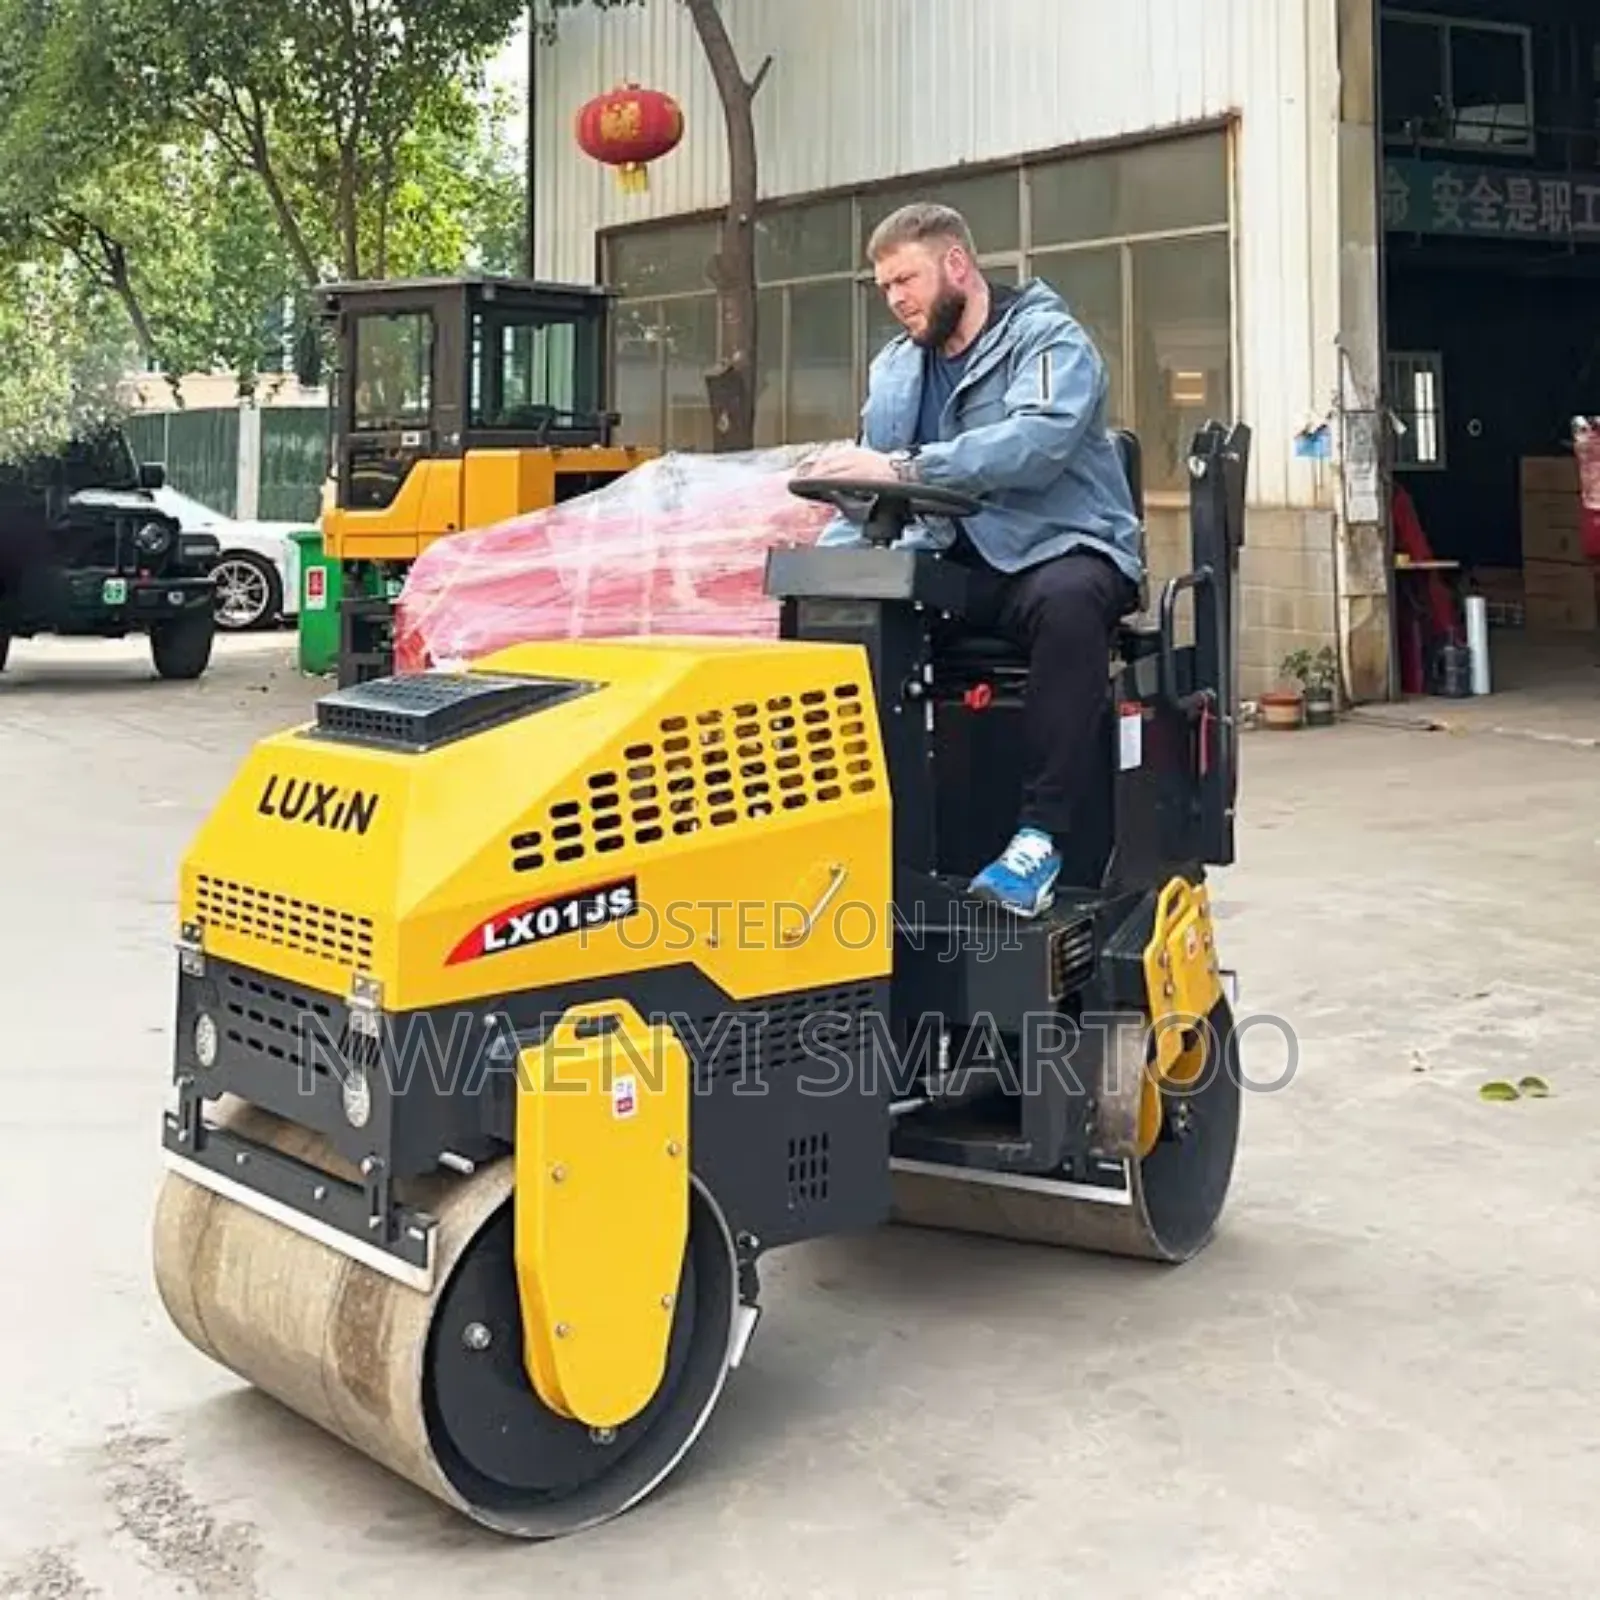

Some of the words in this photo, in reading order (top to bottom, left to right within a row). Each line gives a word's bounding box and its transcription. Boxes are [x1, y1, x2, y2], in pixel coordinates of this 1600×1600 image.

[1432, 170, 1600, 233] 安全是职工
[484, 886, 632, 951] LX01JS
